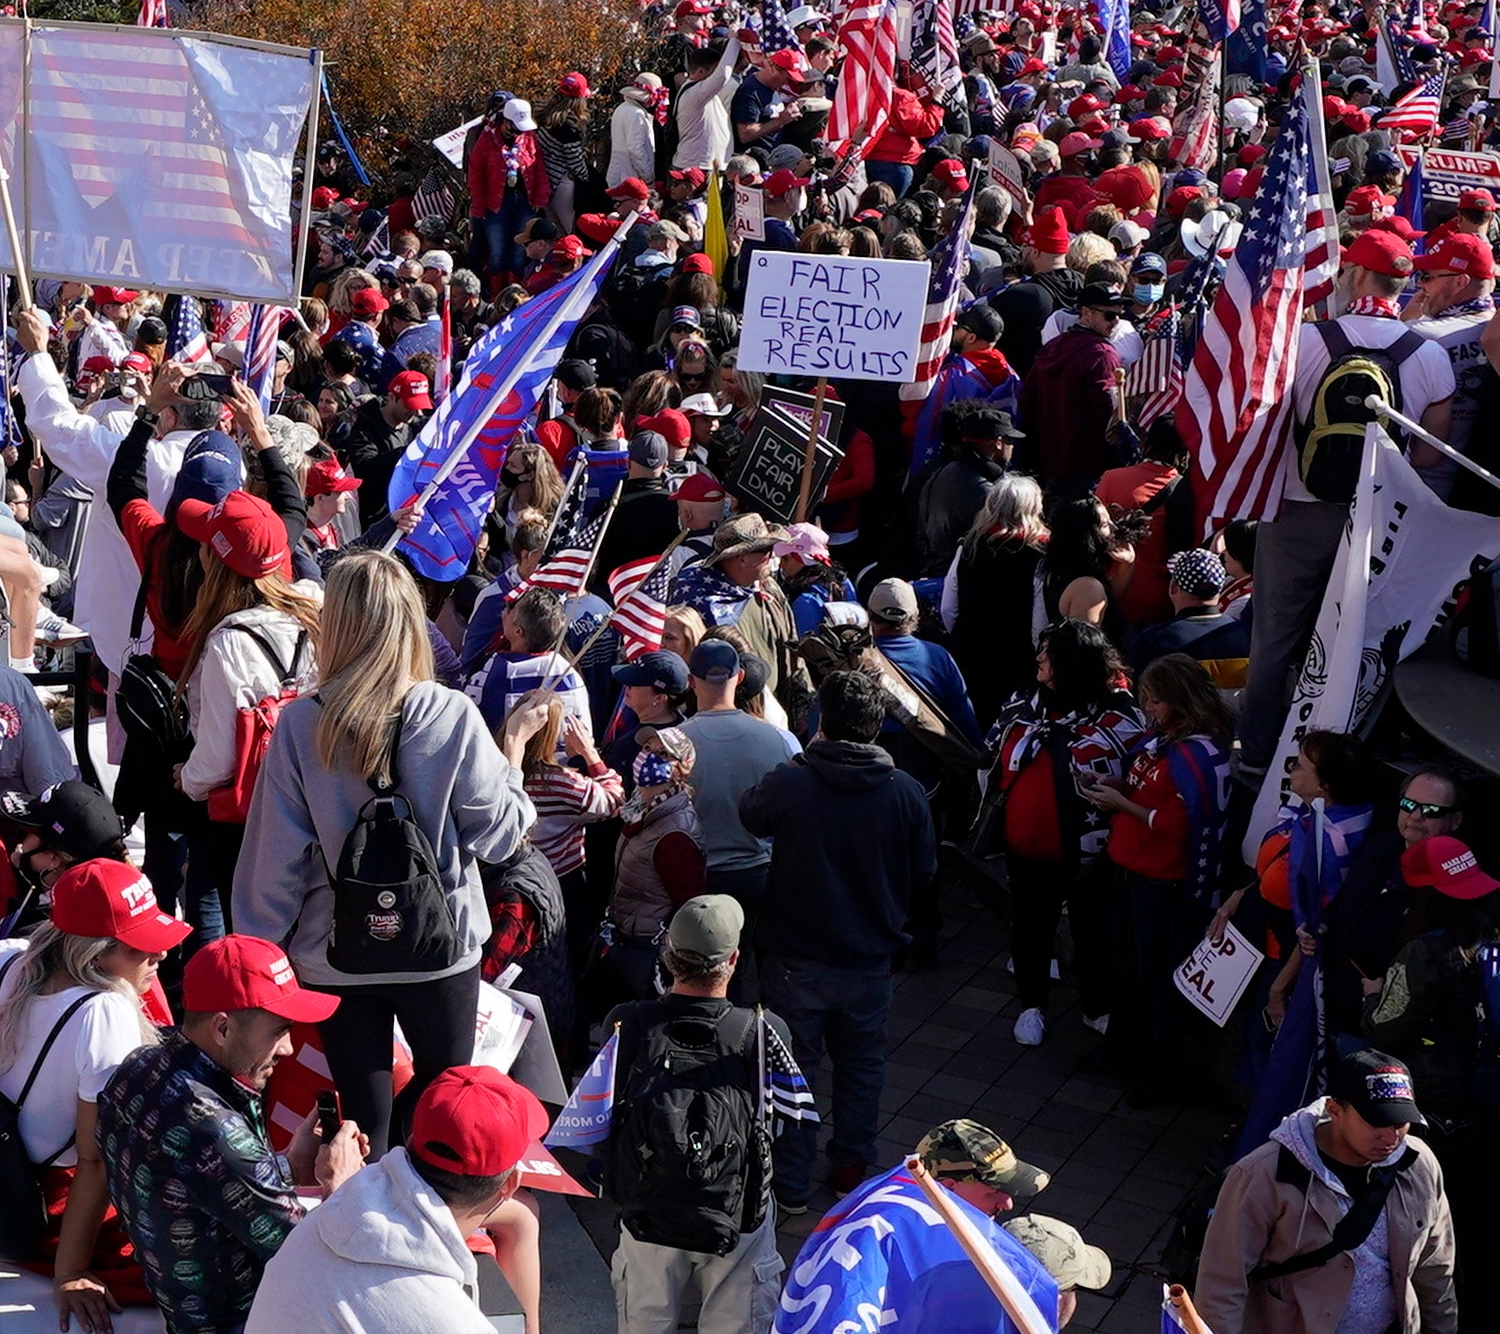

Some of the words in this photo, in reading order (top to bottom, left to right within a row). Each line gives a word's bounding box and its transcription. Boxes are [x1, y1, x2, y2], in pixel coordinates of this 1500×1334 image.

[789, 260, 882, 301] FAIR
[760, 297, 903, 332] ELECTION
[778, 321, 858, 348] REAL
[763, 339, 909, 378] RESULTS
[762, 437, 806, 474] PLAY
[747, 475, 787, 508] DNC
[755, 459, 796, 490] FAIR
[369, 913, 400, 926] Trump
